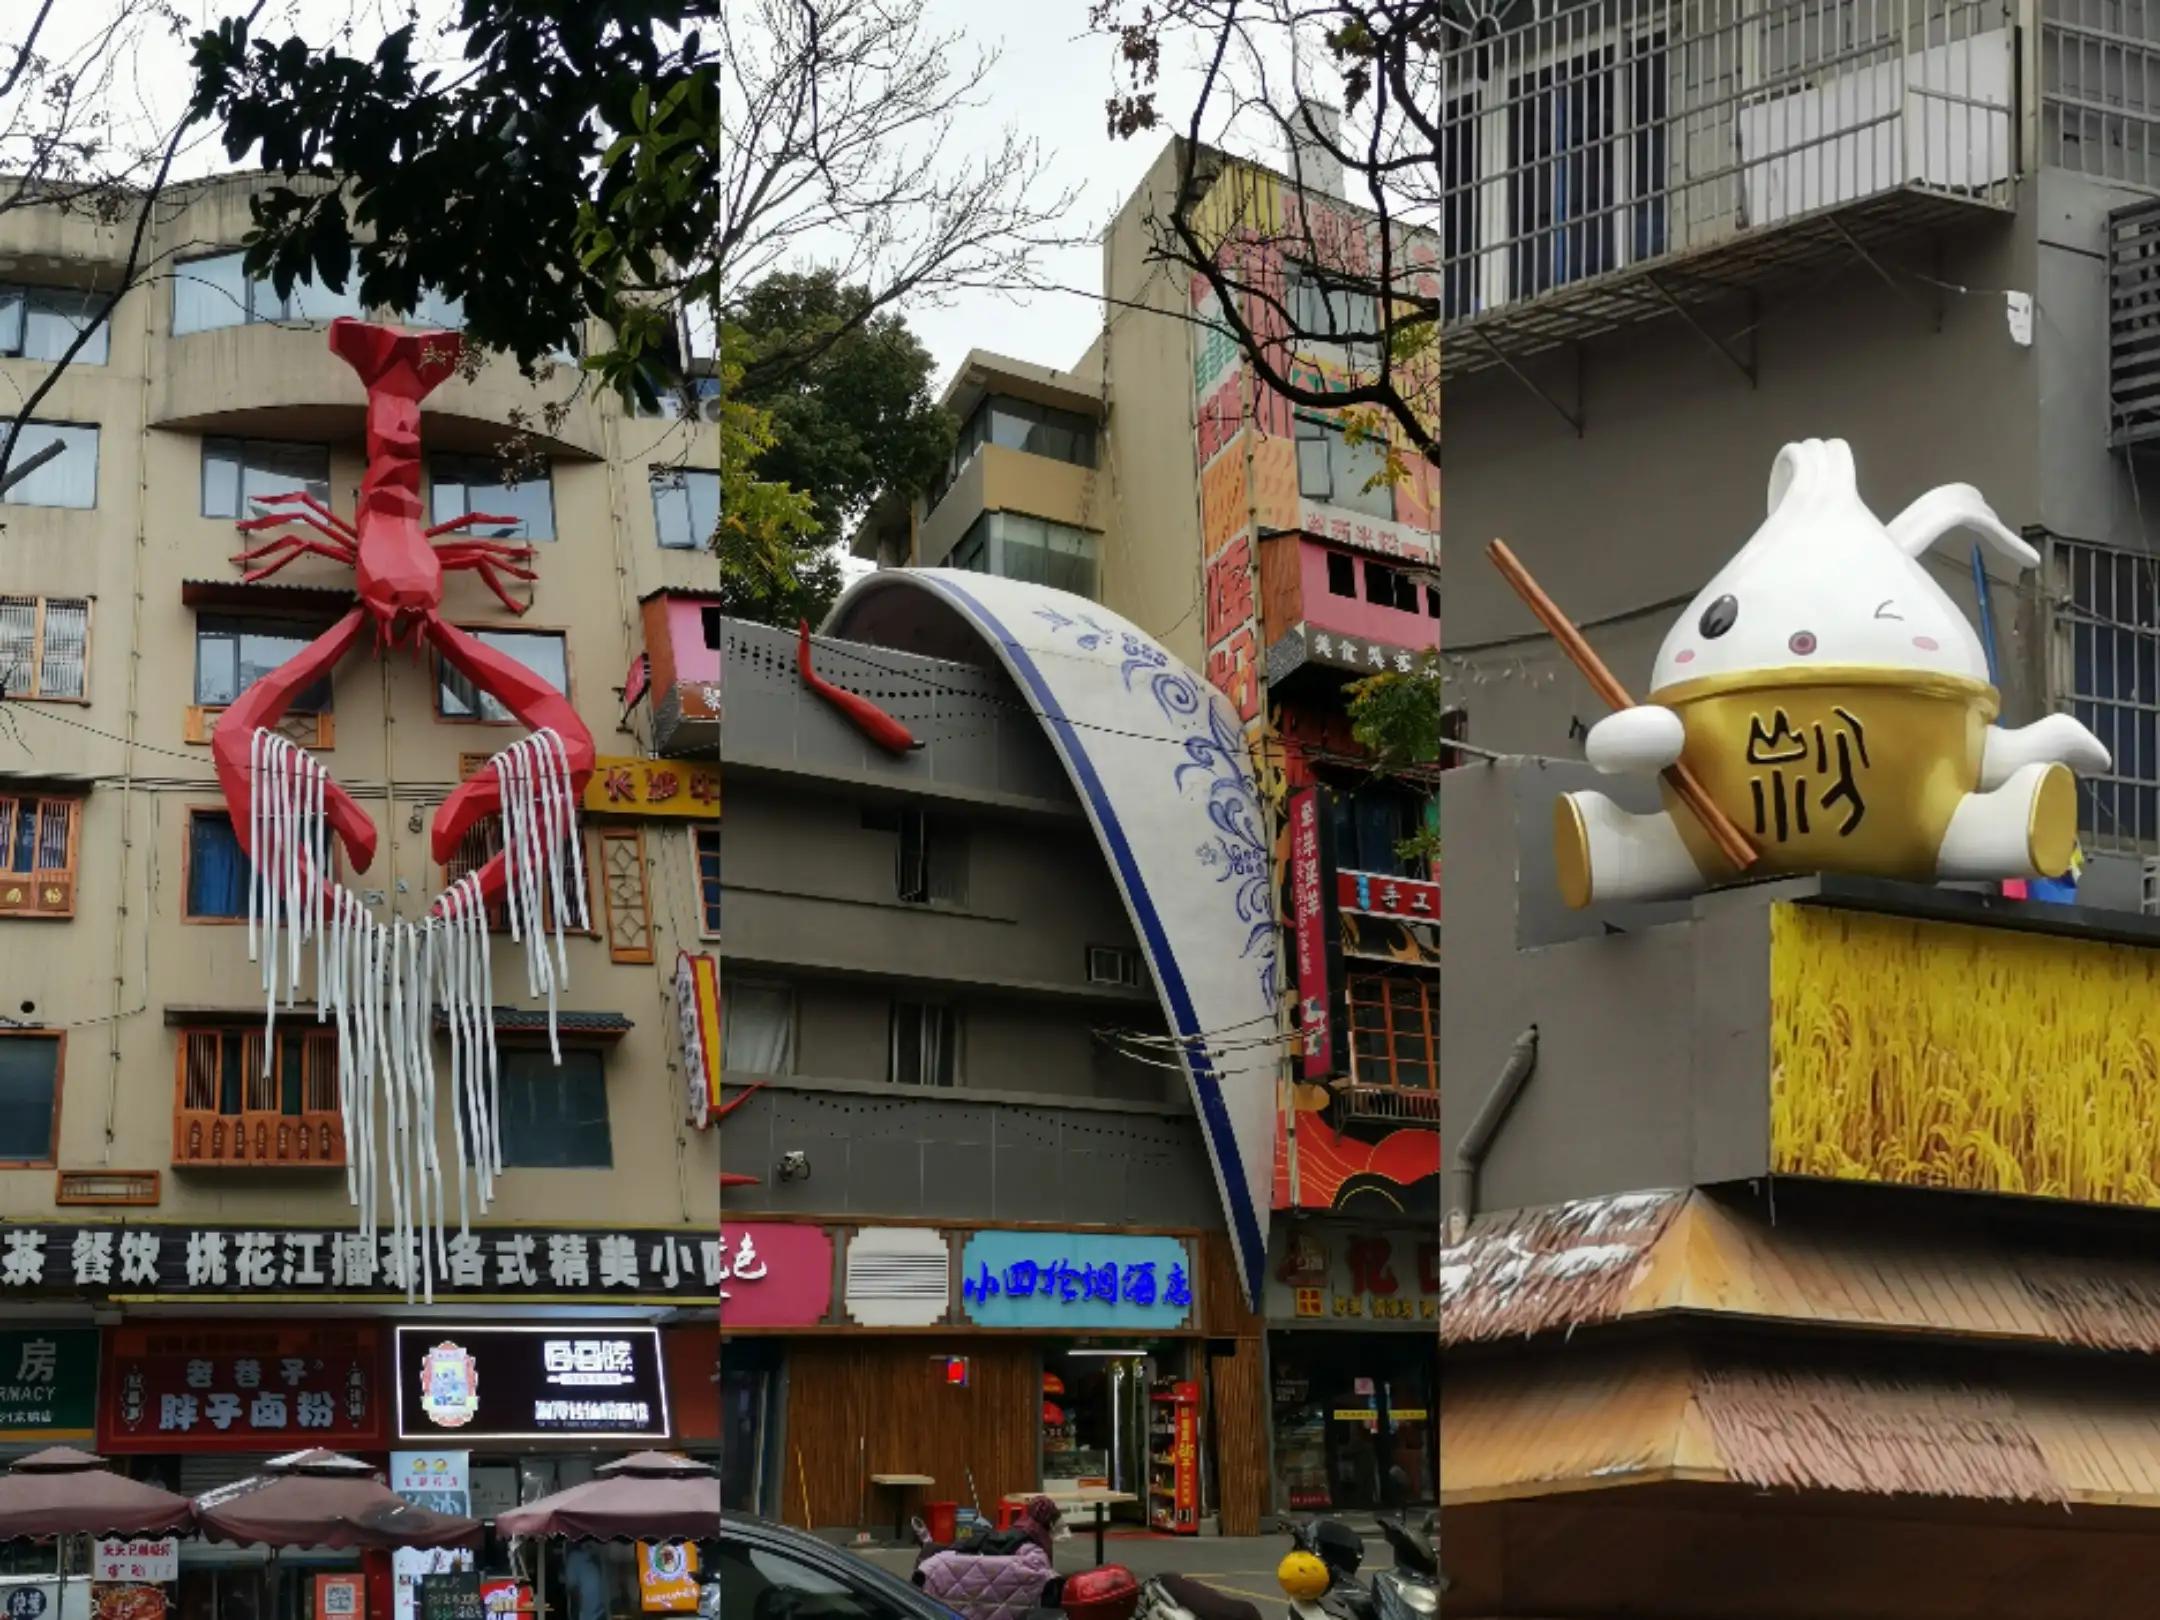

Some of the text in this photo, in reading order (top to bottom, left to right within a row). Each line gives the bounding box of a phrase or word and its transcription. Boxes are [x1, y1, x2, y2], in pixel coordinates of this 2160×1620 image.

[1380, 883, 1432, 911] 手工
[2, 1230, 47, 1285] 茶
[71, 1230, 160, 1285] 餐饮
[16, 1338, 57, 1382] 房
[158, 1391, 336, 1431] 胖子卤粉
